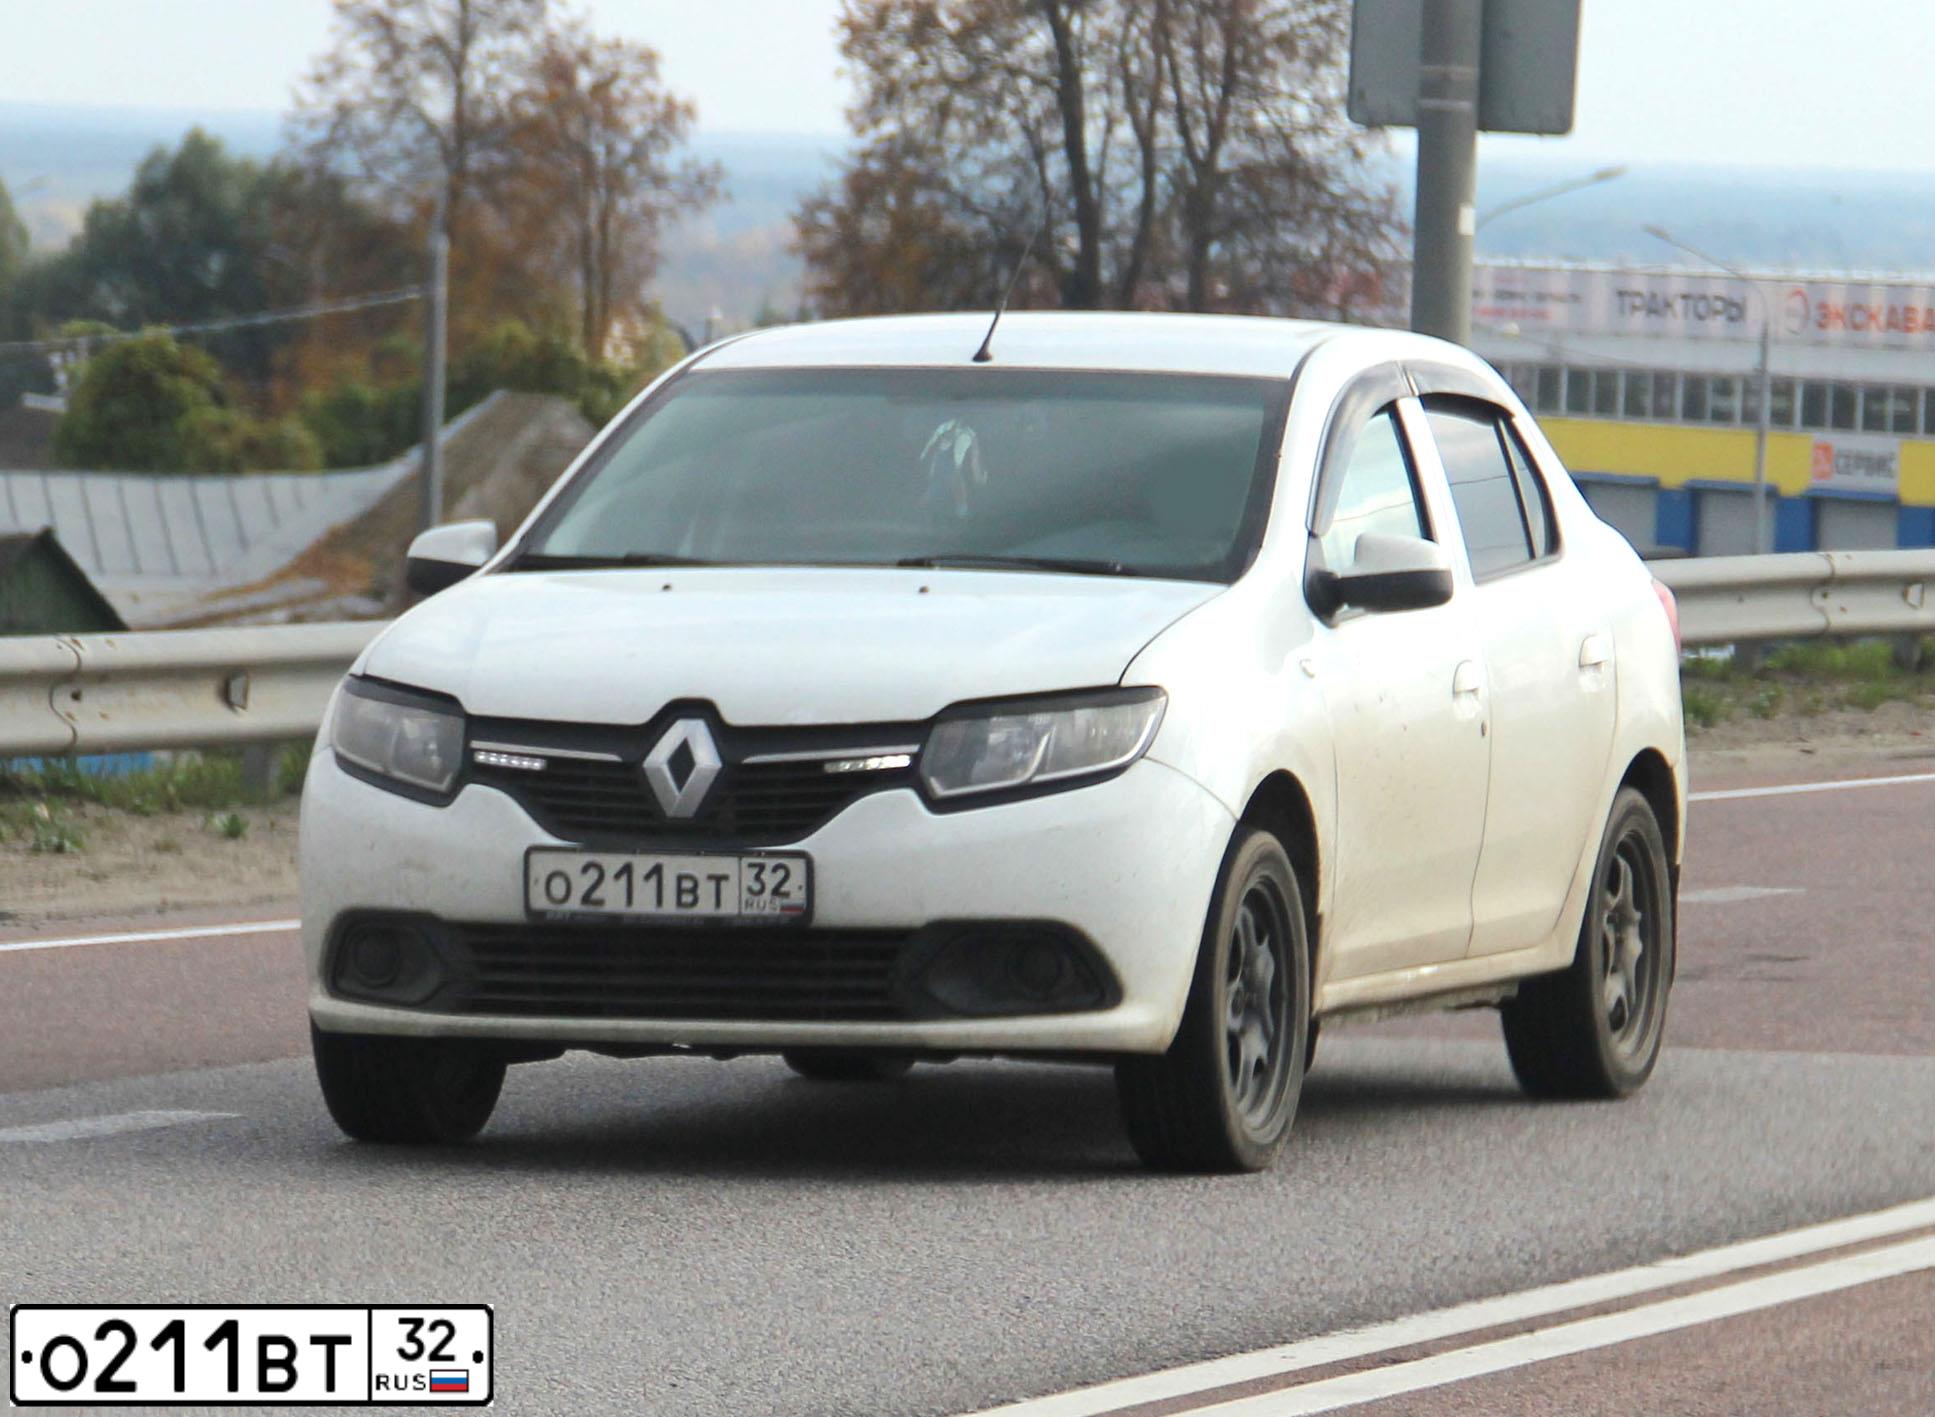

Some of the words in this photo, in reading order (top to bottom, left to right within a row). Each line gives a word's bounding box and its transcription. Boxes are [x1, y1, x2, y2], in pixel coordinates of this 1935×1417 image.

[1616, 289, 1747, 323] ТРАКТОРЫ
[747, 862, 792, 897] 32
[744, 898, 777, 912] RUS
